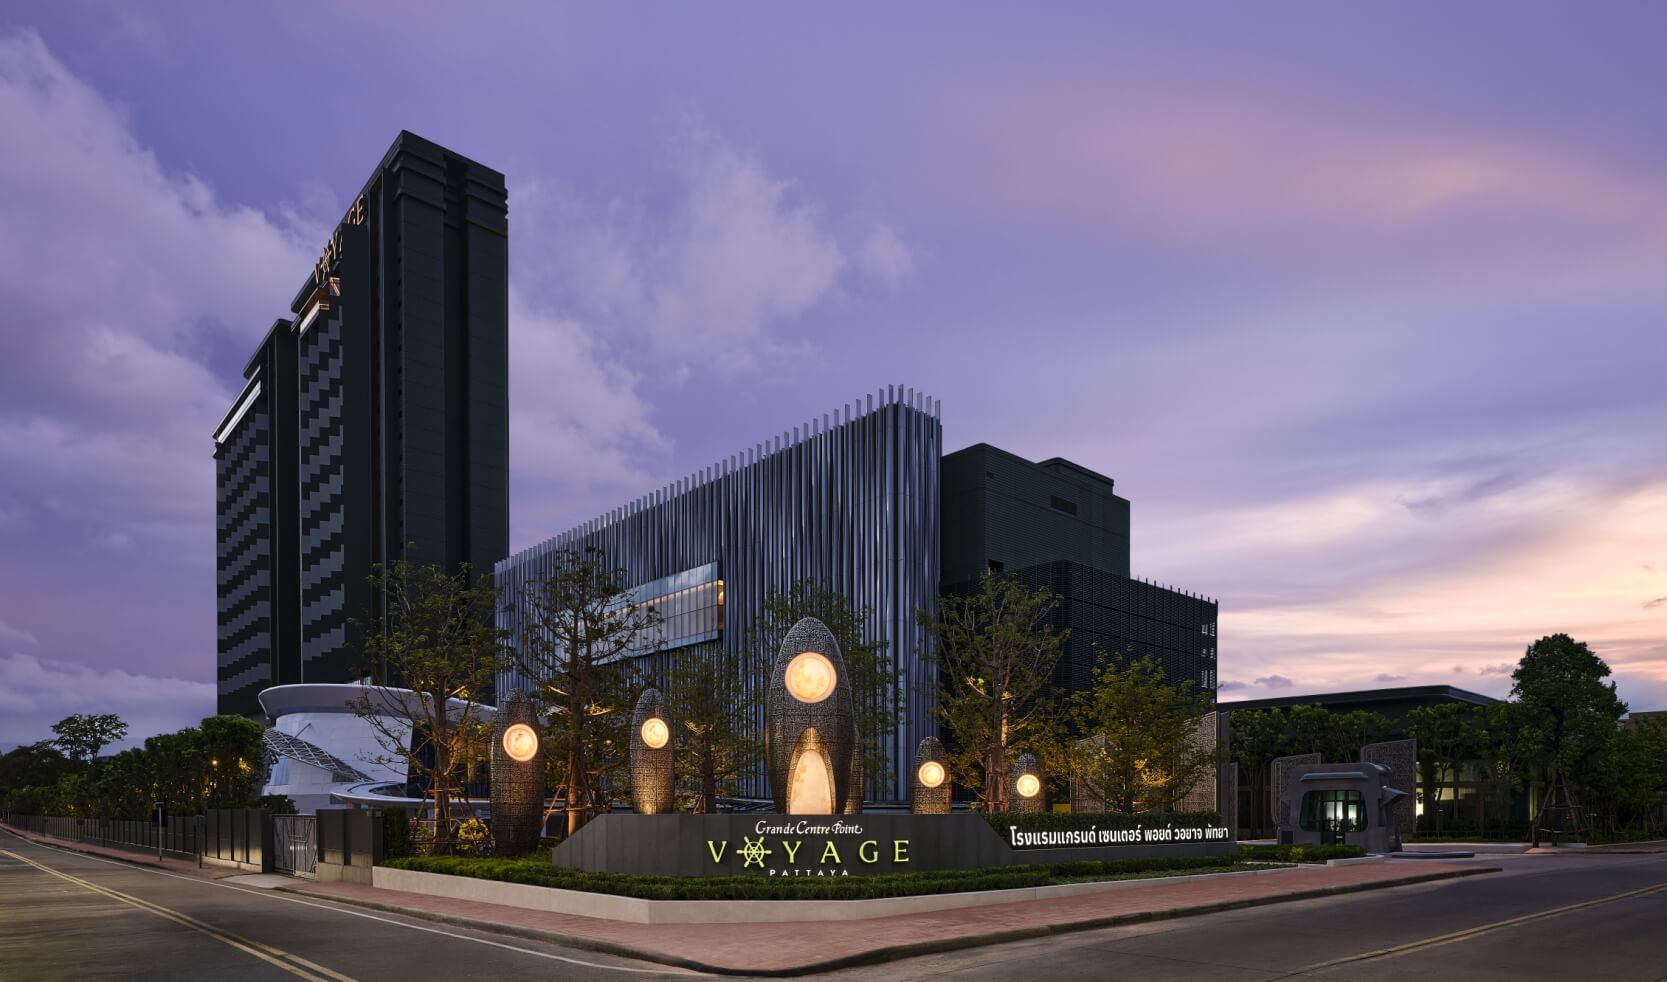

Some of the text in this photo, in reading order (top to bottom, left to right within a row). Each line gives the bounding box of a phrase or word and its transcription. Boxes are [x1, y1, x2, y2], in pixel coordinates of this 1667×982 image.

[755, 820, 863, 835] Grande Centre Point
[1009, 823, 1229, 846] โรงแรมแกรนด์ เซนเตอร์ พอยต์ วอยาจ พัทยา
[769, 869, 849, 877] PATTAYA
